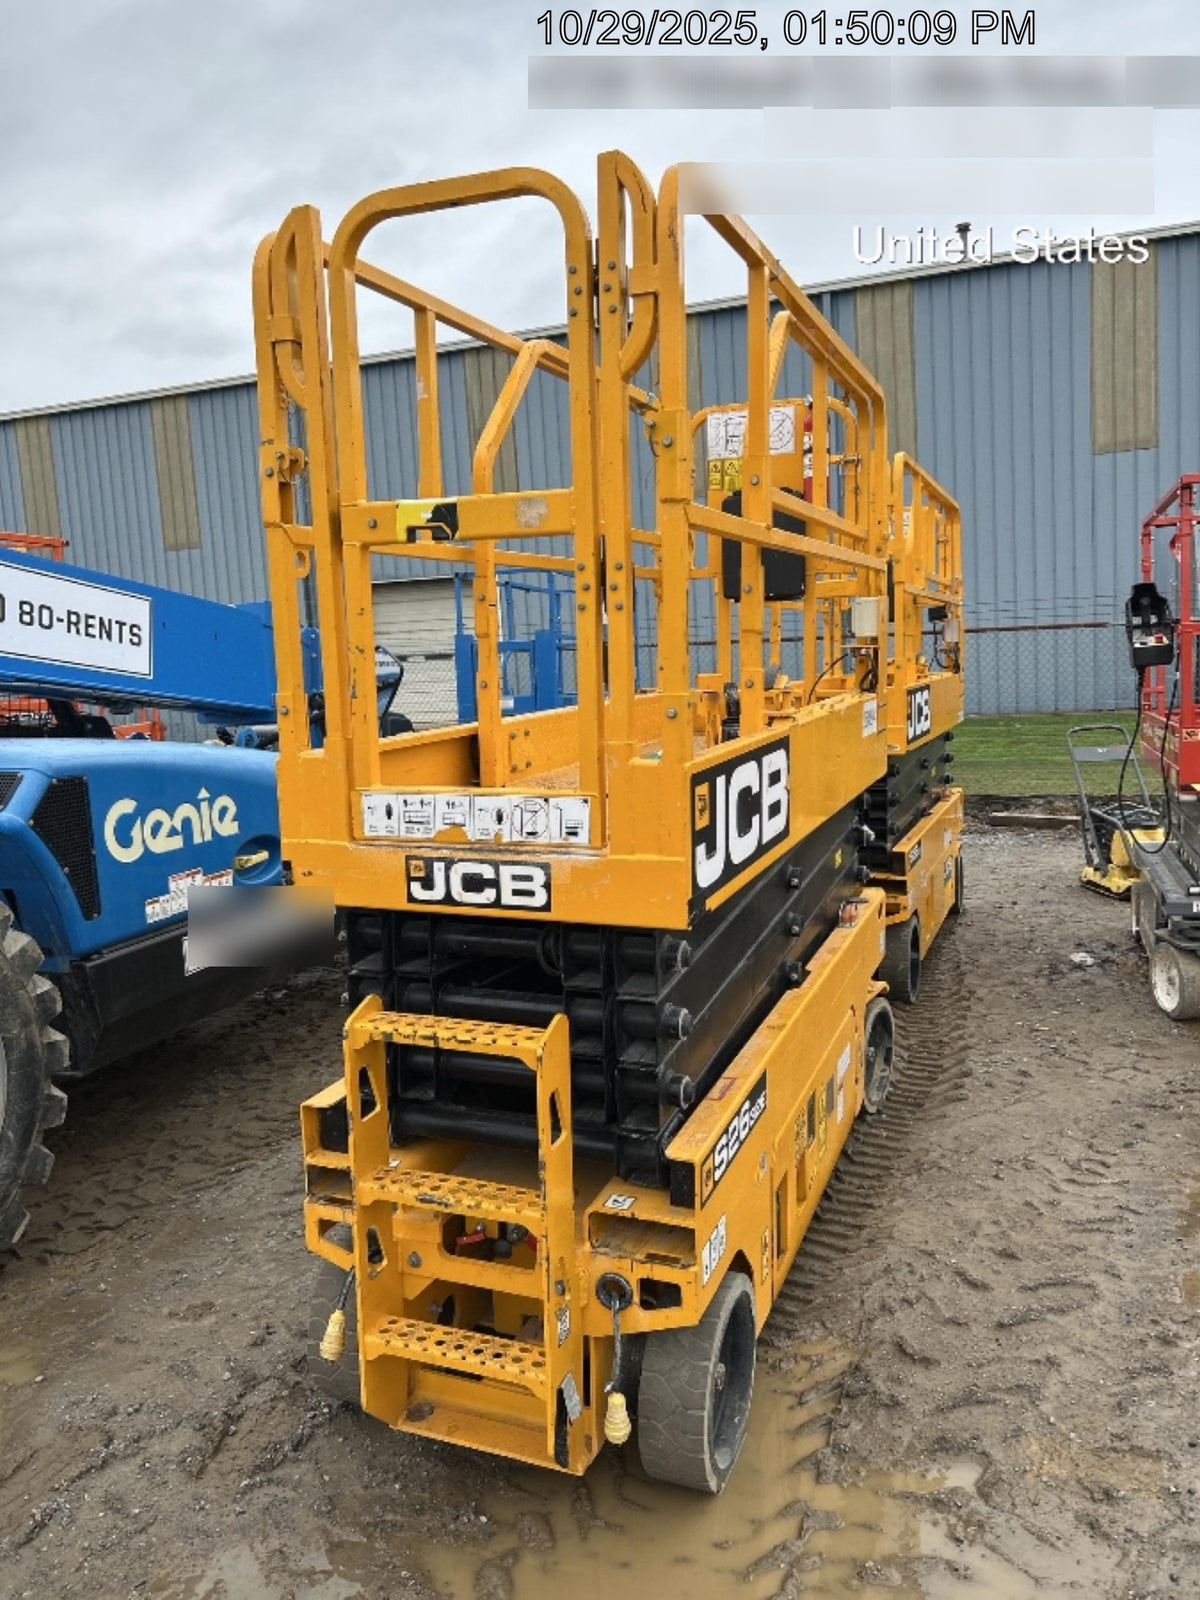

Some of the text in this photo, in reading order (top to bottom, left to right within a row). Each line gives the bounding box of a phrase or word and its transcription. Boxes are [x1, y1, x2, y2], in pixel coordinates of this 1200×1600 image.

[18, 600, 142, 647] 80-RENTS
[907, 689, 930, 741] JCB
[104, 787, 240, 863] Genie
[695, 748, 789, 888] JCB
[410, 861, 548, 908] JCB
